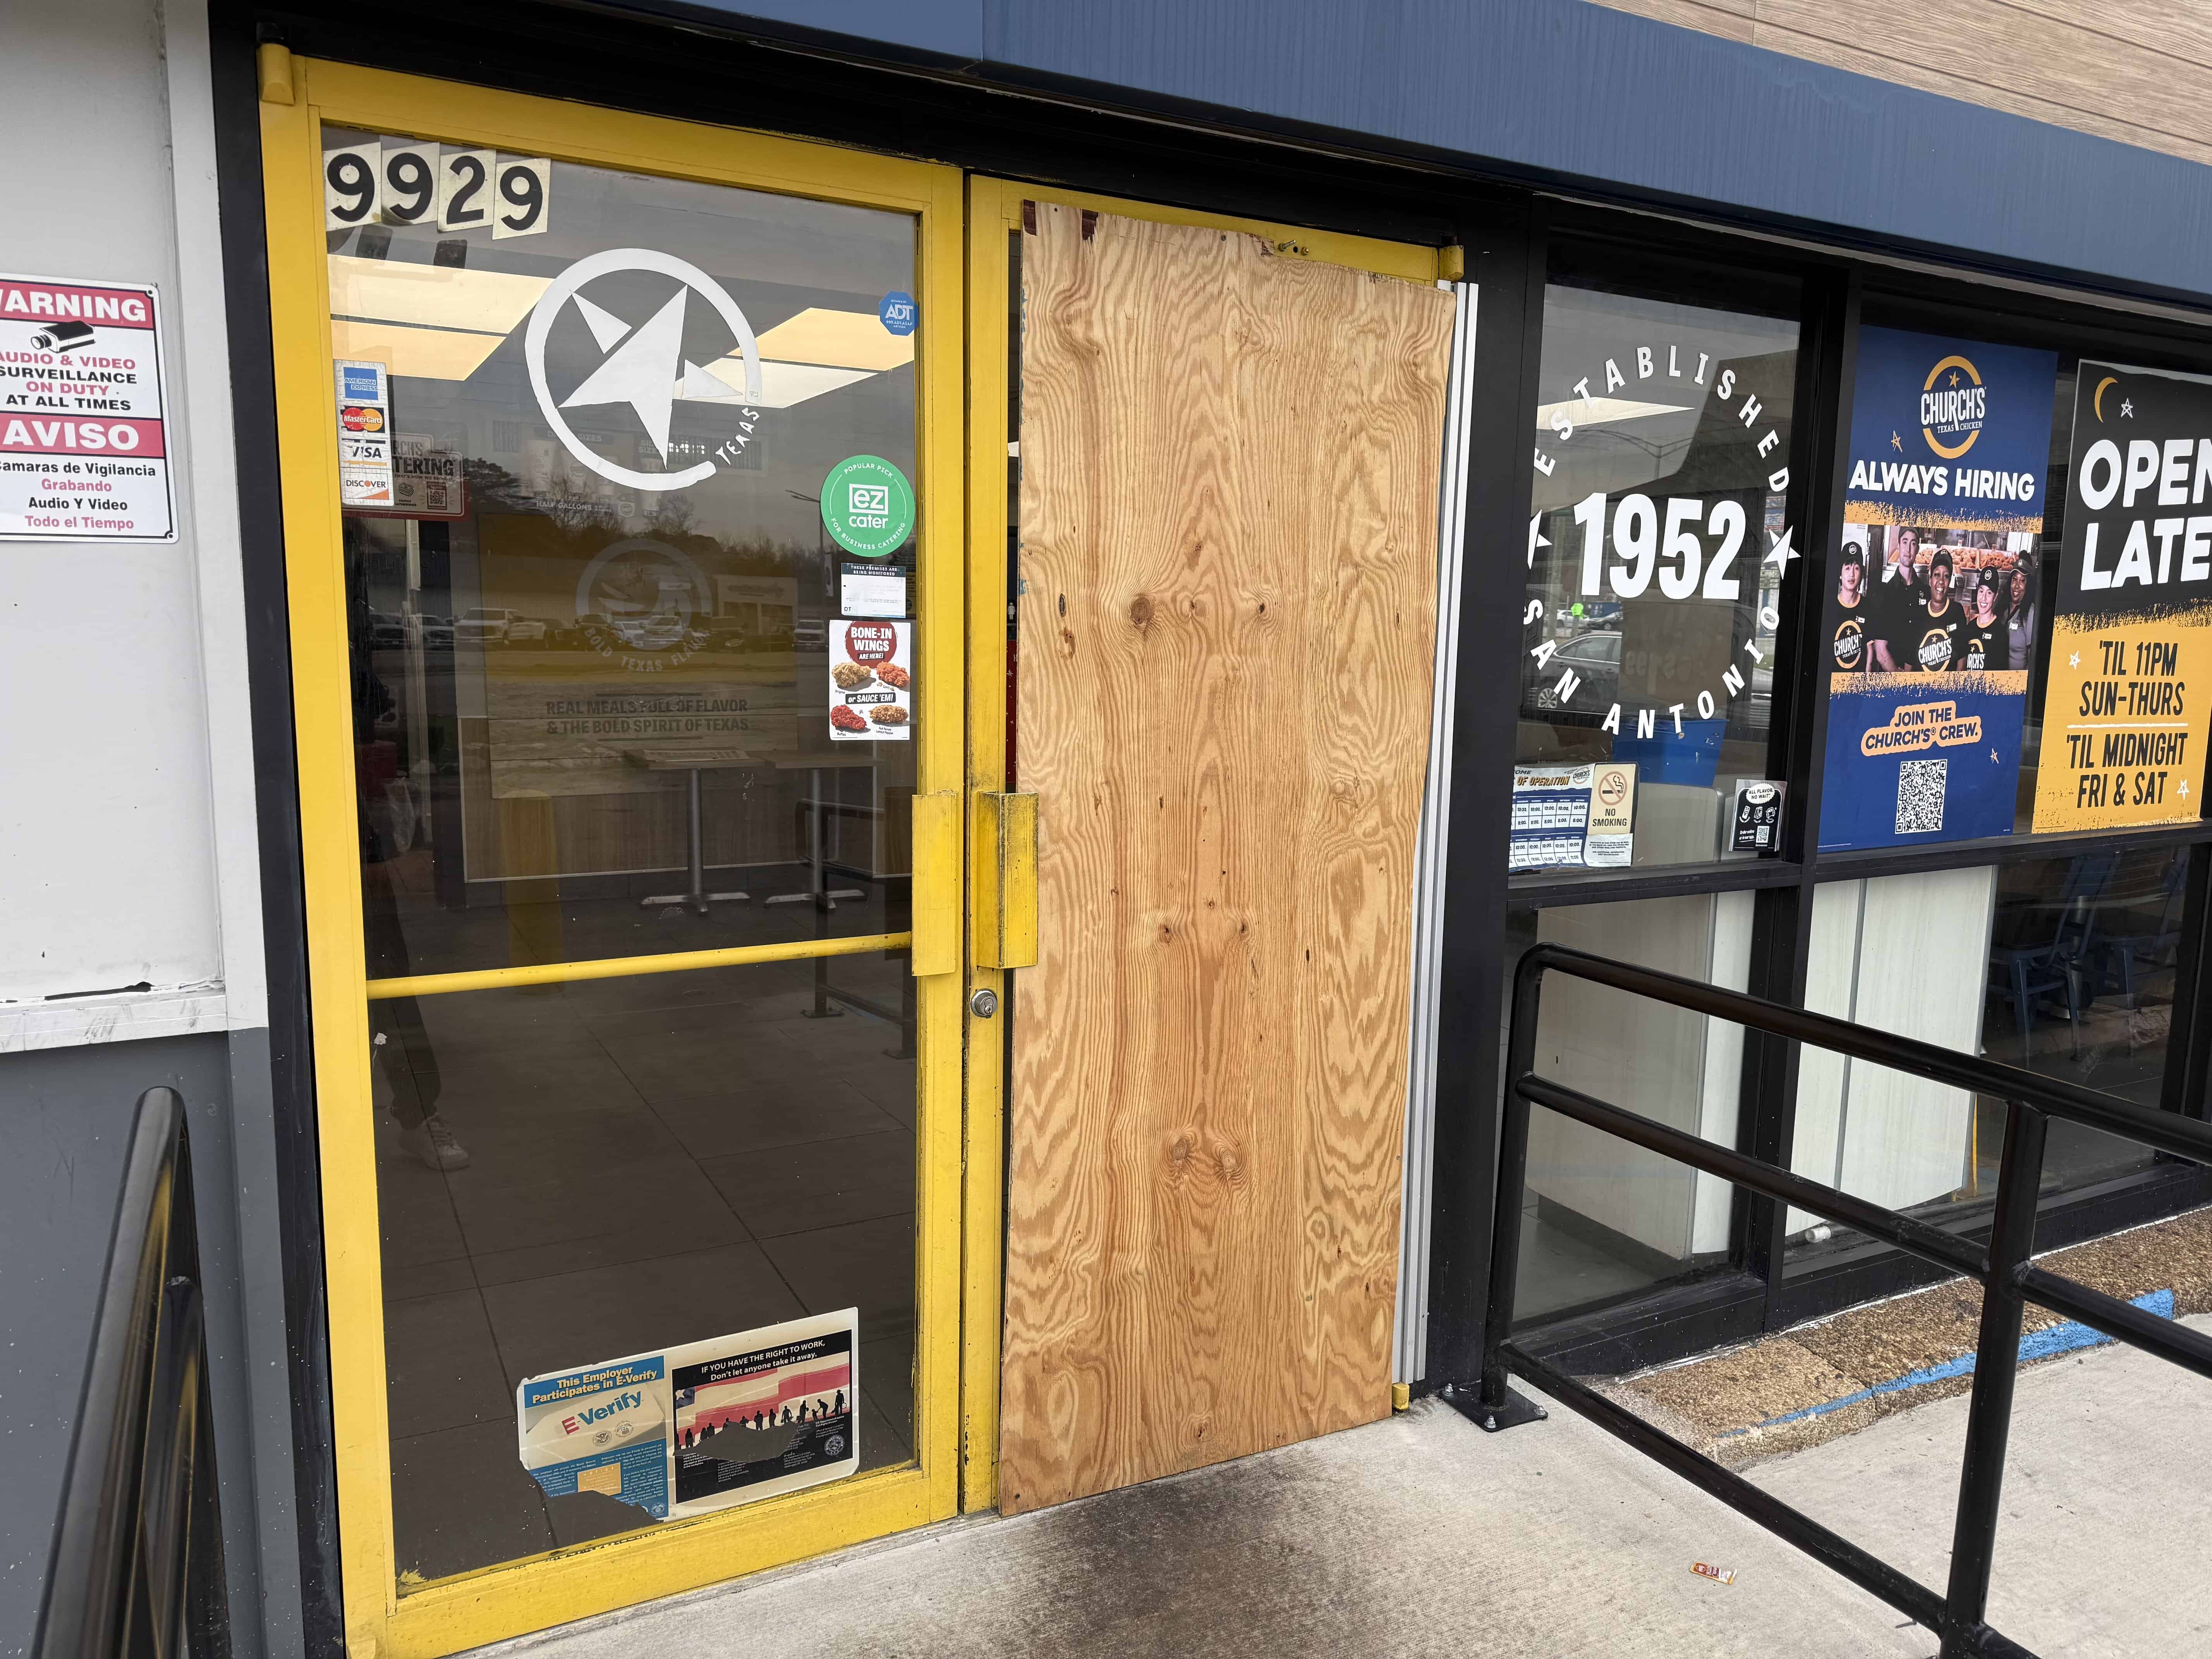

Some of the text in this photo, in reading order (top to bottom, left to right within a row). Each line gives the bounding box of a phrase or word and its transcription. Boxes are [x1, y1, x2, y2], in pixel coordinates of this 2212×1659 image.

[327, 153, 543, 231] 9929
[0, 289, 146, 322] ARNING
[885, 304, 913, 320] ADT
[60, 354, 73, 366] &
[80, 356, 136, 370] VIDEO
[26, 381, 109, 396] ON DUTY
[6, 394, 131, 410] AT ALL TIMES
[1921, 386, 1985, 425] CHURCH'S
[343, 414, 382, 424] MasterCard
[1534, 345, 1789, 492] ESTABLISHED
[1937, 421, 1982, 434] TEXAS CHICKEN
[2, 419, 139, 450] AVISO
[0, 461, 156, 477] amaras de Vigilancia
[392, 456, 453, 476] TERING
[844, 463, 893, 478] POPULAR PICK
[41, 479, 112, 492] Grabando
[346, 480, 386, 488] DISCOVER
[1849, 460, 2035, 501] ALWAYS HIRING
[28, 497, 128, 511] Audio Y Video
[854, 489, 884, 509] ez
[24, 515, 134, 531] Todo el Tiempo
[849, 515, 888, 529] cater
[831, 517, 905, 550] FOR BUSINESS CATERING
[1573, 492, 1746, 600] 1952
[2081, 516, 2212, 591] LATE
[851, 627, 892, 639] BONE-IN
[854, 640, 890, 652] WINGS
[1918, 638, 1952, 664] CHURCH'S
[621, 655, 663, 672] TEXAS
[2099, 640, 2178, 676] 'TIL 11PM
[1523, 599, 1779, 738] SAN ANTONIO
[546, 700, 583, 714] REAL
[696, 699, 748, 712] FLAVOR
[857, 694, 878, 703] SAUCE
[879, 694, 893, 702] 'EM!
[2079, 681, 2185, 716] SUN-THURS
[546, 718, 749, 734] & THE BOLD SPIRIT OF TEXAS
[1894, 707, 1952, 728] JOIN THE
[1939, 723, 1978, 740] CREW.
[2066, 732, 2188, 769] 'TIL MIDNIGHT
[1517, 776, 1570, 786] OF OPERATION
[2077, 771, 2168, 809] FRI & SAT
[1592, 819, 1627, 827] SMOKING
[701, 1340, 825, 1374] IF YOU HAVE THE RIGHT TO WORK,
[711, 1370, 732, 1381] Don't
[744, 1363, 771, 1374] anyone
[773, 1358, 789, 1368] take
[797, 1353, 817, 1362] away.
[532, 1370, 658, 1404] Participates in E-Verify
[557, 1367, 633, 1389] This Employer
[562, 1391, 642, 1435] E-Verify
